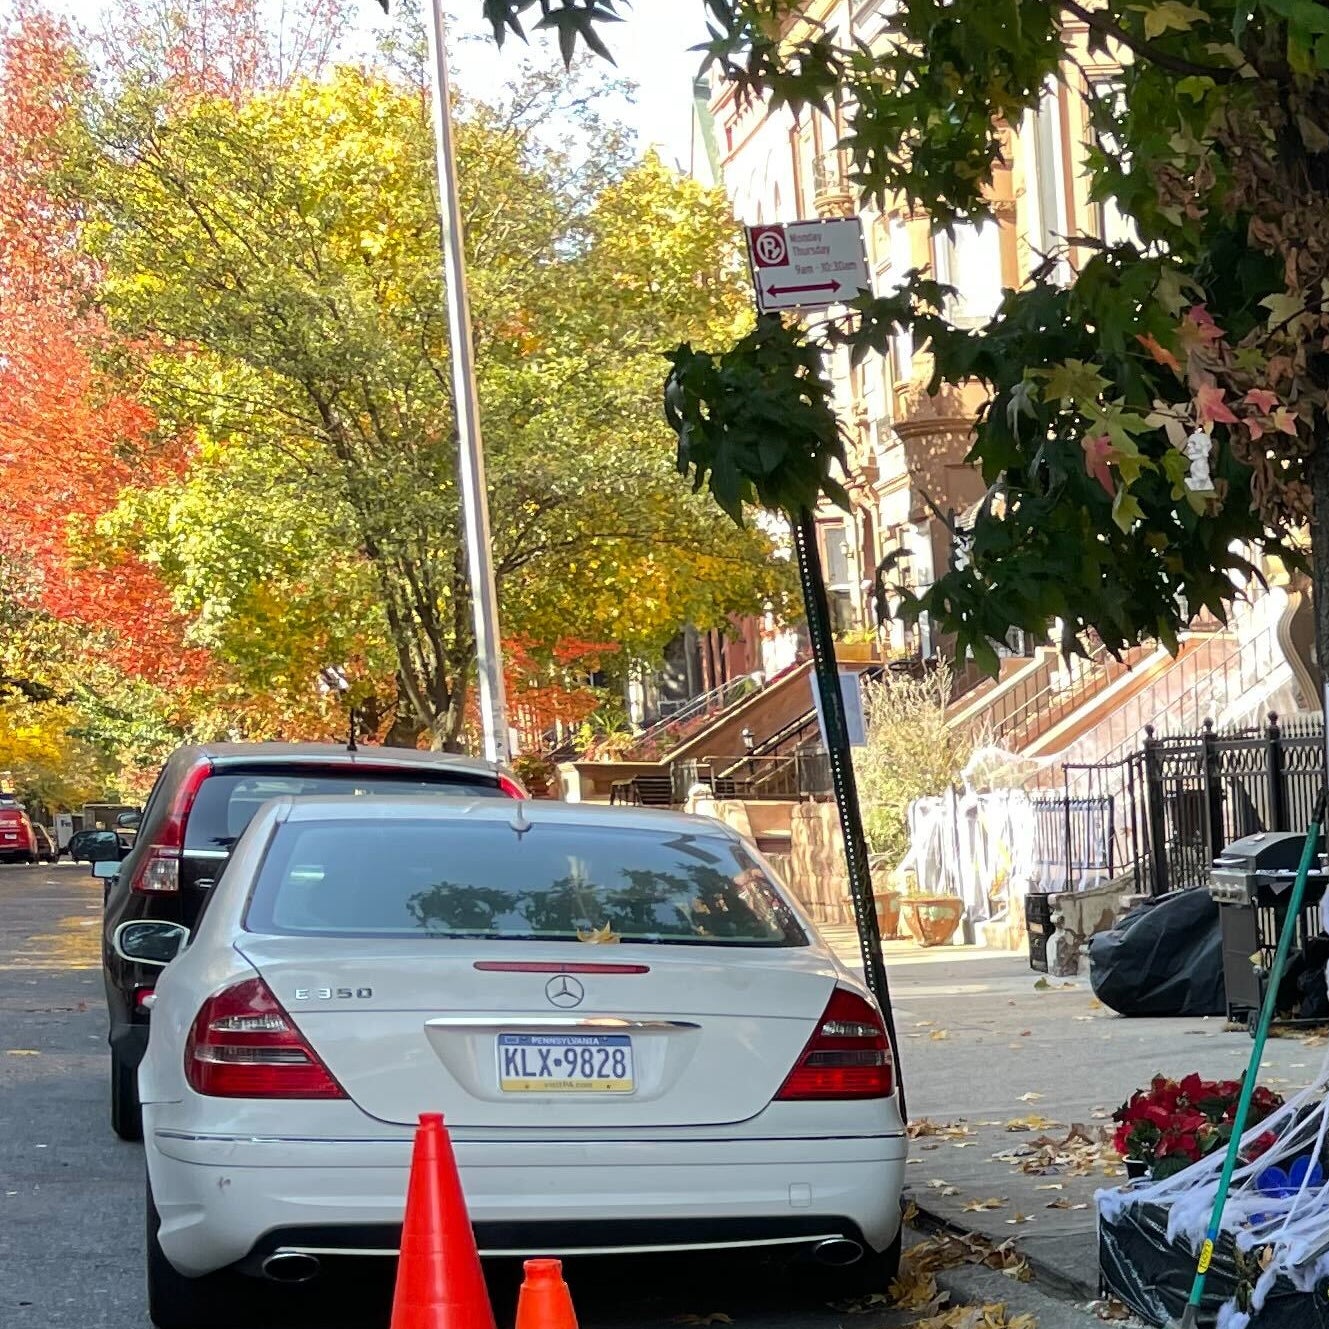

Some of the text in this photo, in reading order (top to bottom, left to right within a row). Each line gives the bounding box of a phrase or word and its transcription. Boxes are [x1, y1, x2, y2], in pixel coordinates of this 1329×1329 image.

[790, 233, 822, 244] Monday
[793, 244, 831, 257] Thursday
[795, 264, 814, 275] 9am
[317, 986, 375, 1000] 350
[531, 1036, 600, 1045] PENNSYLVANIA
